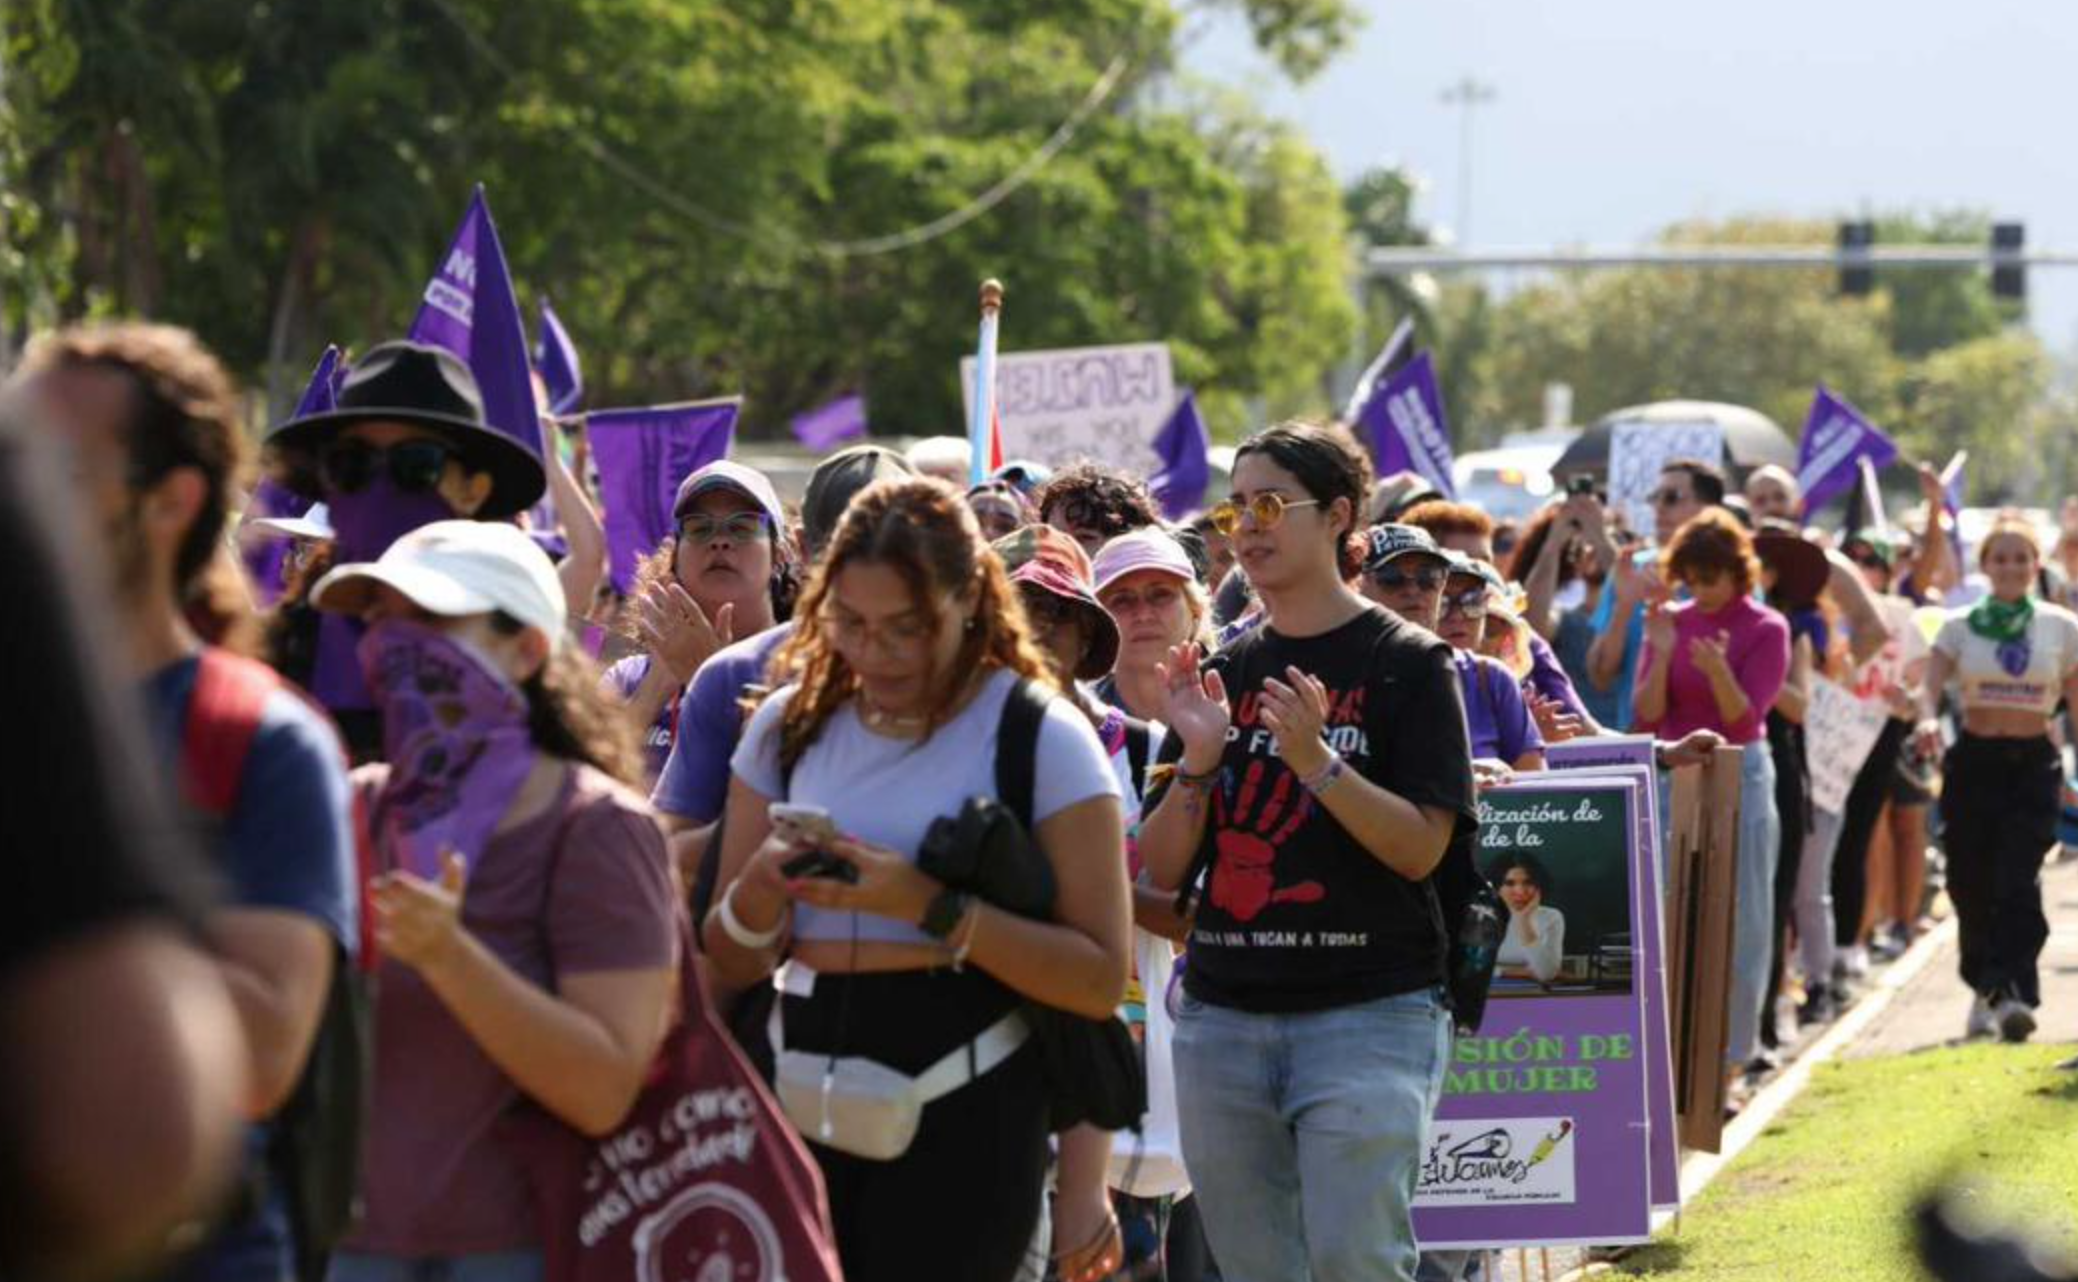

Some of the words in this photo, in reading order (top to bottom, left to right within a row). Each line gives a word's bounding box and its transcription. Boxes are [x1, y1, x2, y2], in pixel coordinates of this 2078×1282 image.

[974, 352, 1160, 416] MUJE
[1573, 798, 1603, 822] de
[1481, 824, 1512, 847] de
[1516, 824, 1543, 846] la
[1252, 931, 1297, 947] TOCAN
[1302, 931, 1313, 947] A
[1318, 931, 1368, 947] TODAS
[1580, 1033, 1634, 1060] DE
[1441, 1066, 1598, 1095] MUJER
